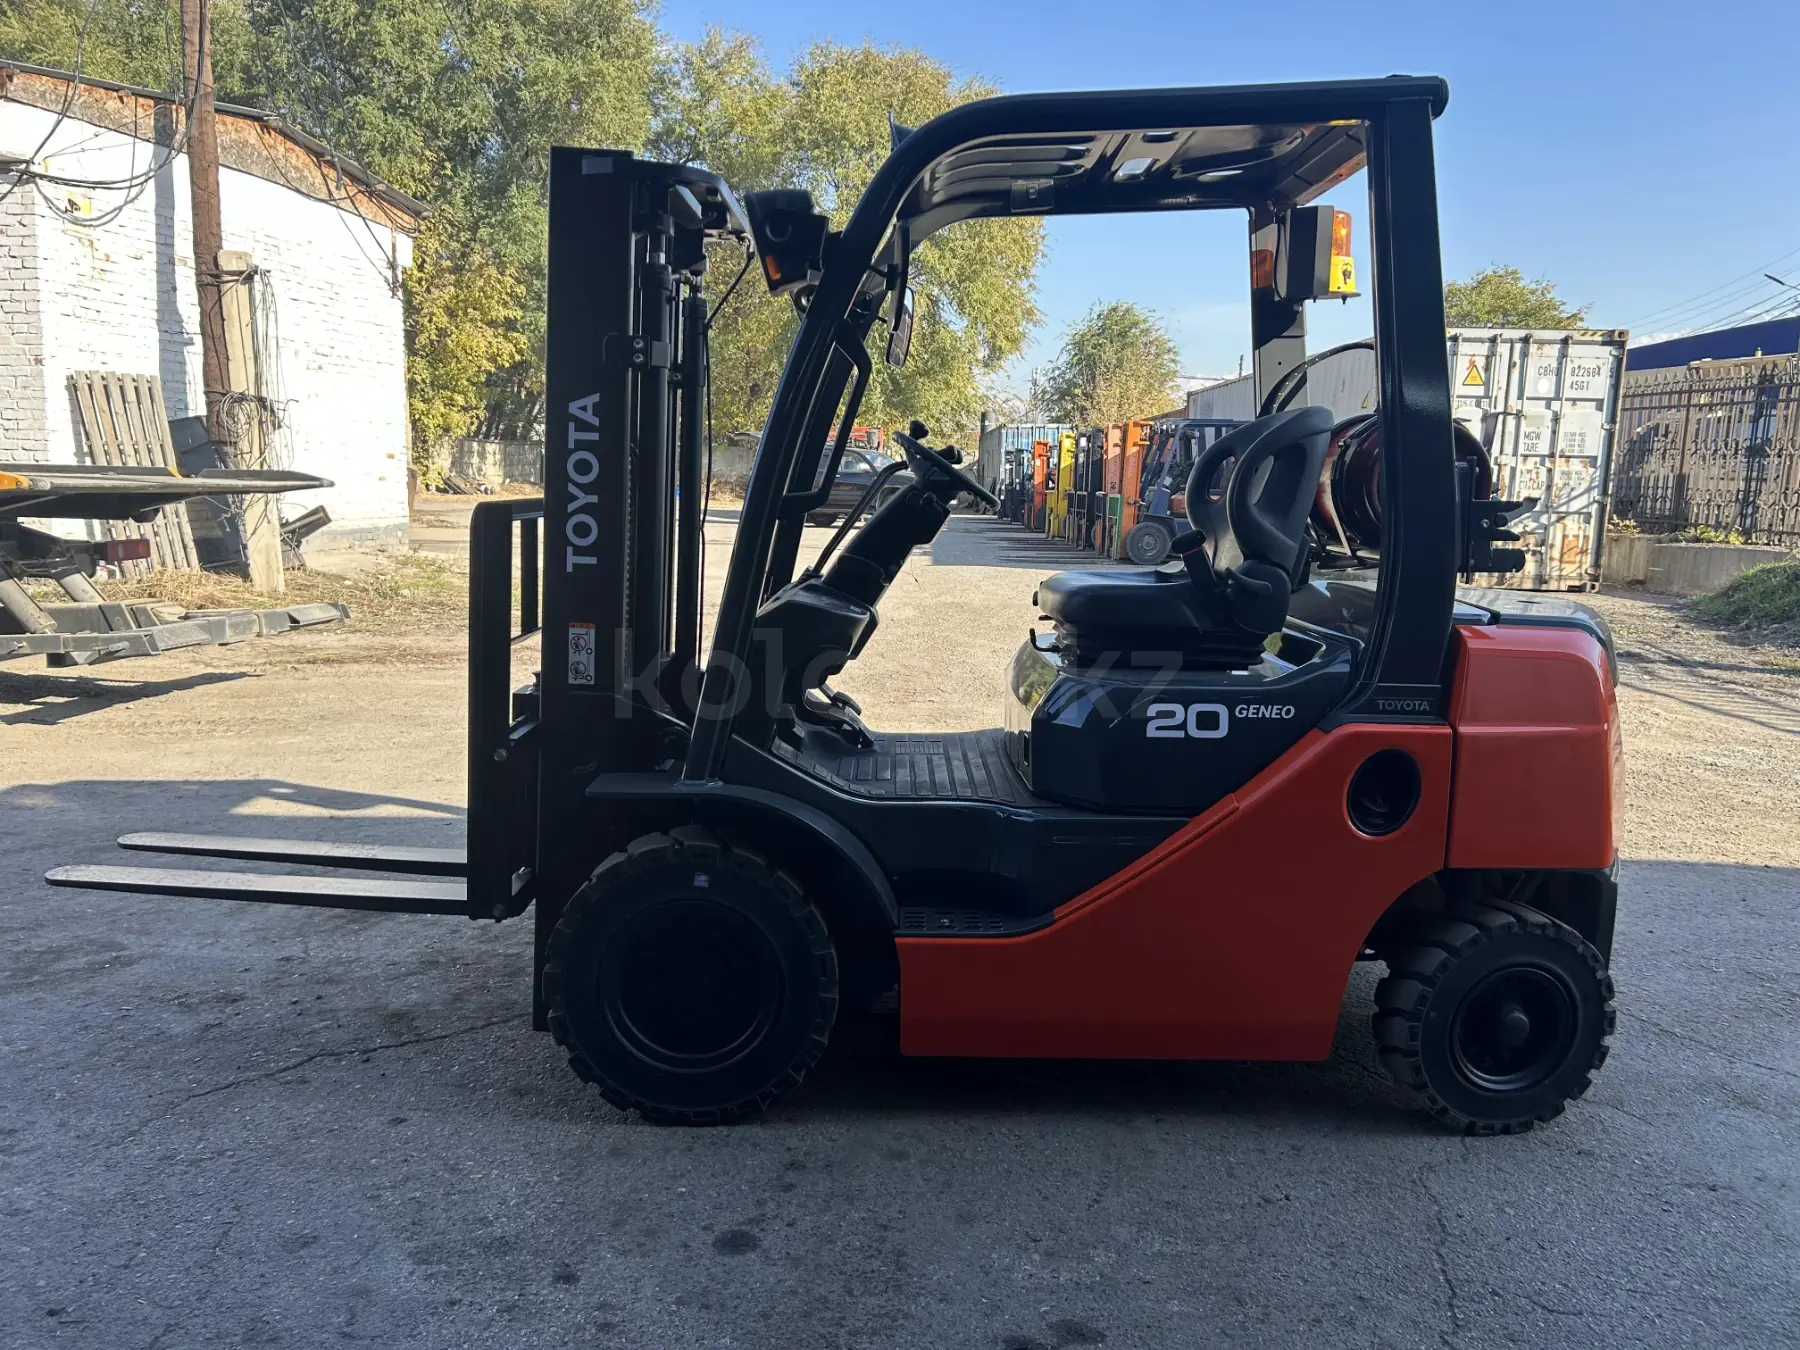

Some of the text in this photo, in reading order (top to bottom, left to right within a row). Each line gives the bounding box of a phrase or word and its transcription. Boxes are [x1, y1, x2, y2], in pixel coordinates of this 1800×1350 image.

[1537, 365, 1560, 377] CBHU
[1569, 380, 1590, 391] 45G1
[1523, 430, 1542, 441] MGW
[1523, 442, 1540, 452] TARE
[565, 392, 600, 573] TOYOTA
[1377, 699, 1430, 712] TOYOTA
[1146, 703, 1295, 739] 20 GENEO
